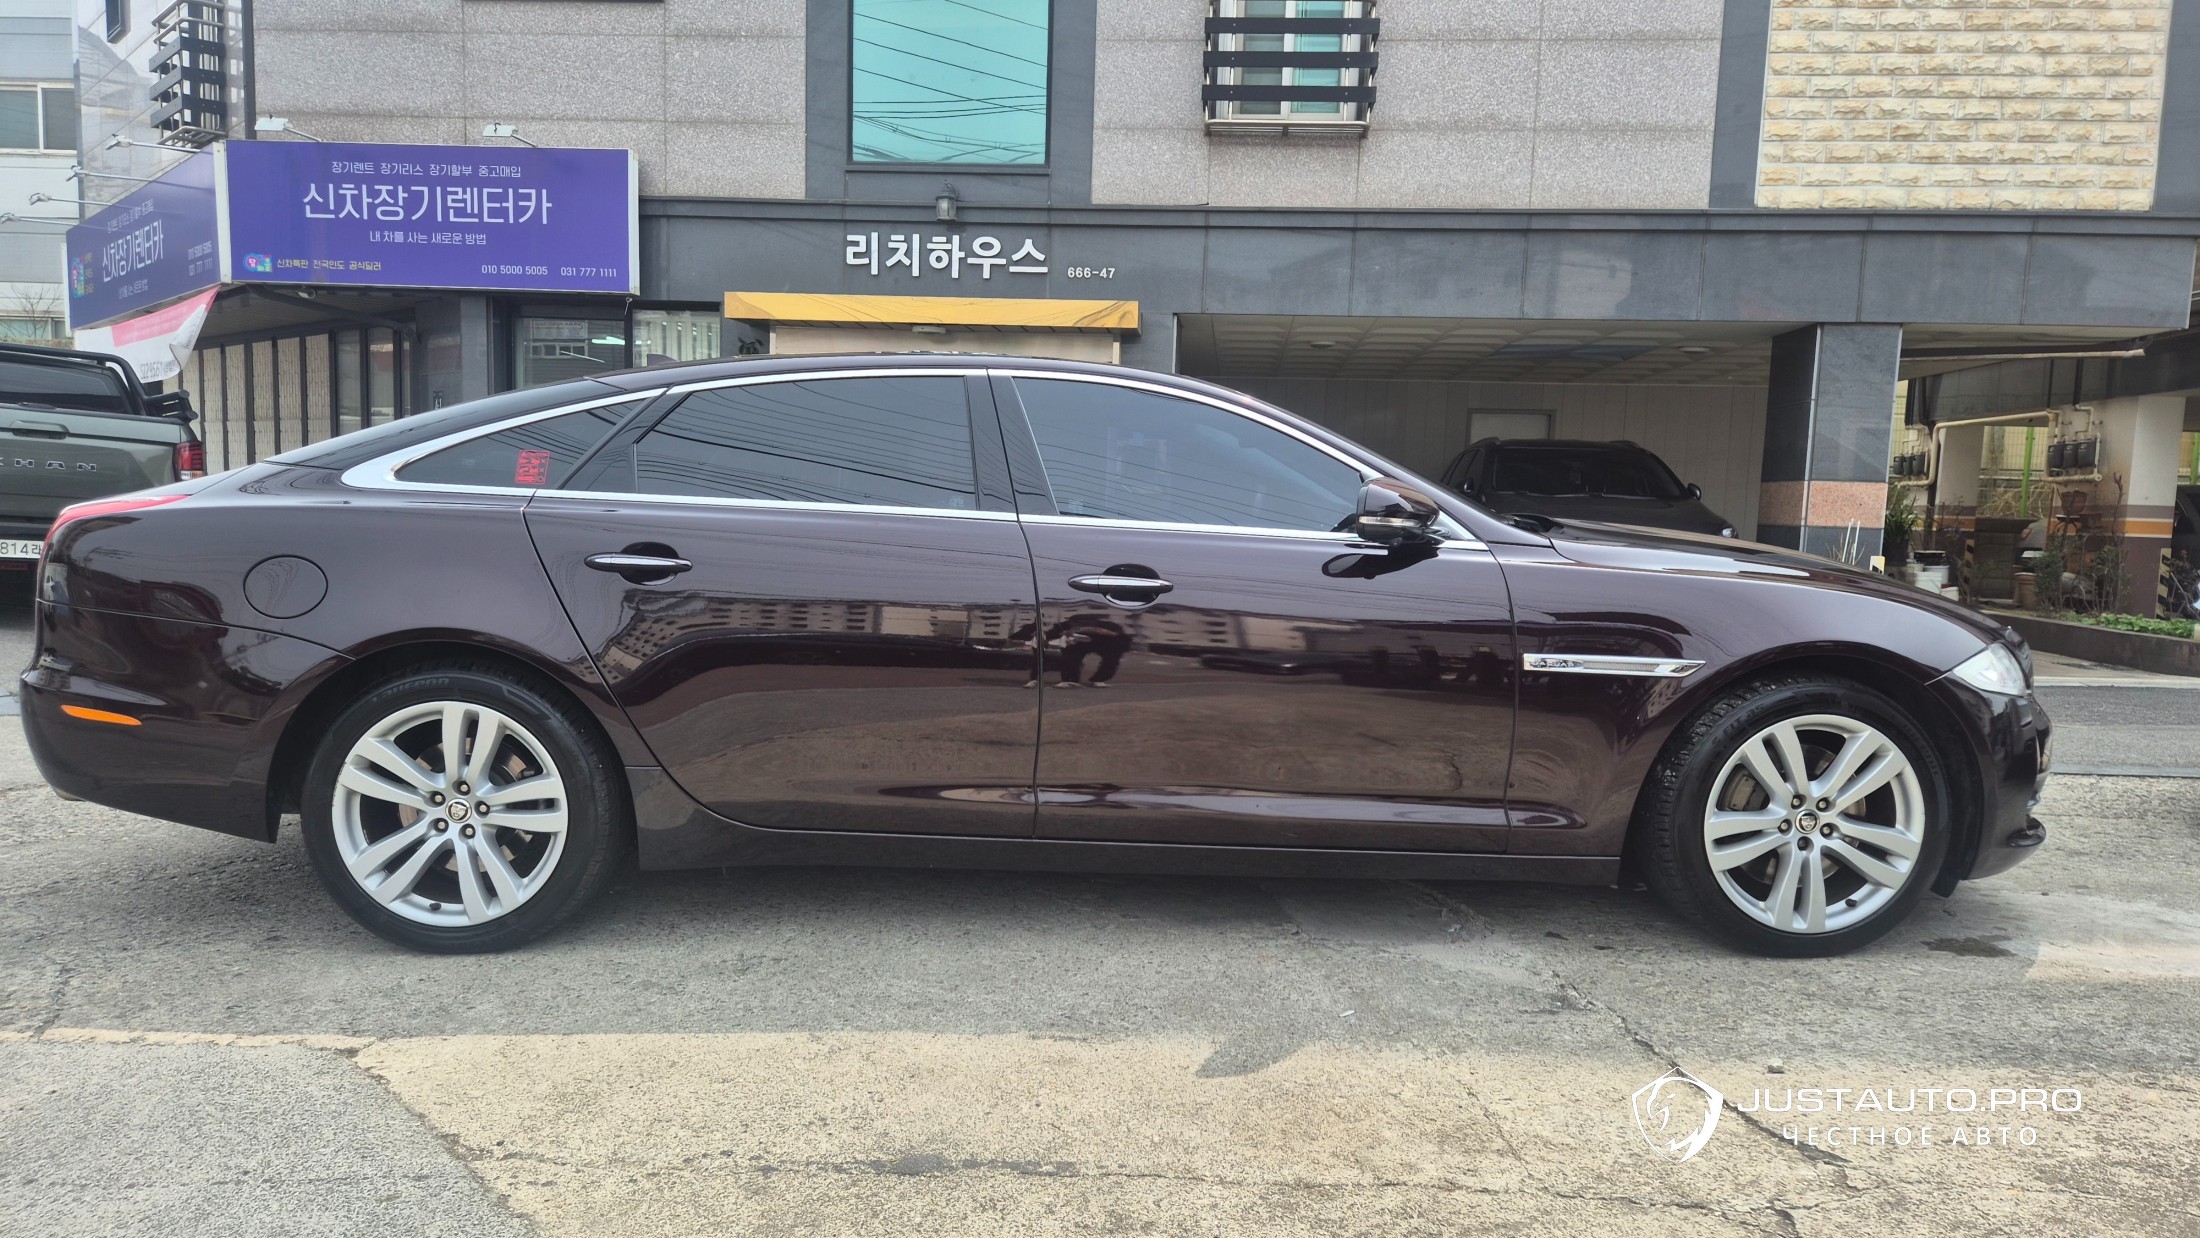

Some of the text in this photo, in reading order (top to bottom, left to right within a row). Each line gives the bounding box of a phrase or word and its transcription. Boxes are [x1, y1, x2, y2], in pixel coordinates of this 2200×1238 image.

[331, 161, 521, 178] 장기렌트 장기리스 장기할부 중고매입
[303, 183, 553, 224] 신차장기렌터카
[369, 230, 487, 245] 내 차를 사는 새로운 방법
[102, 219, 164, 283] 신차장기렌터카
[846, 231, 1049, 279] 리치하우스
[481, 264, 548, 275] 010 5000 5005
[560, 267, 617, 277] 031 777 1111
[1067, 266, 1116, 279] 666-47
[0, 457, 97, 471] HAN
